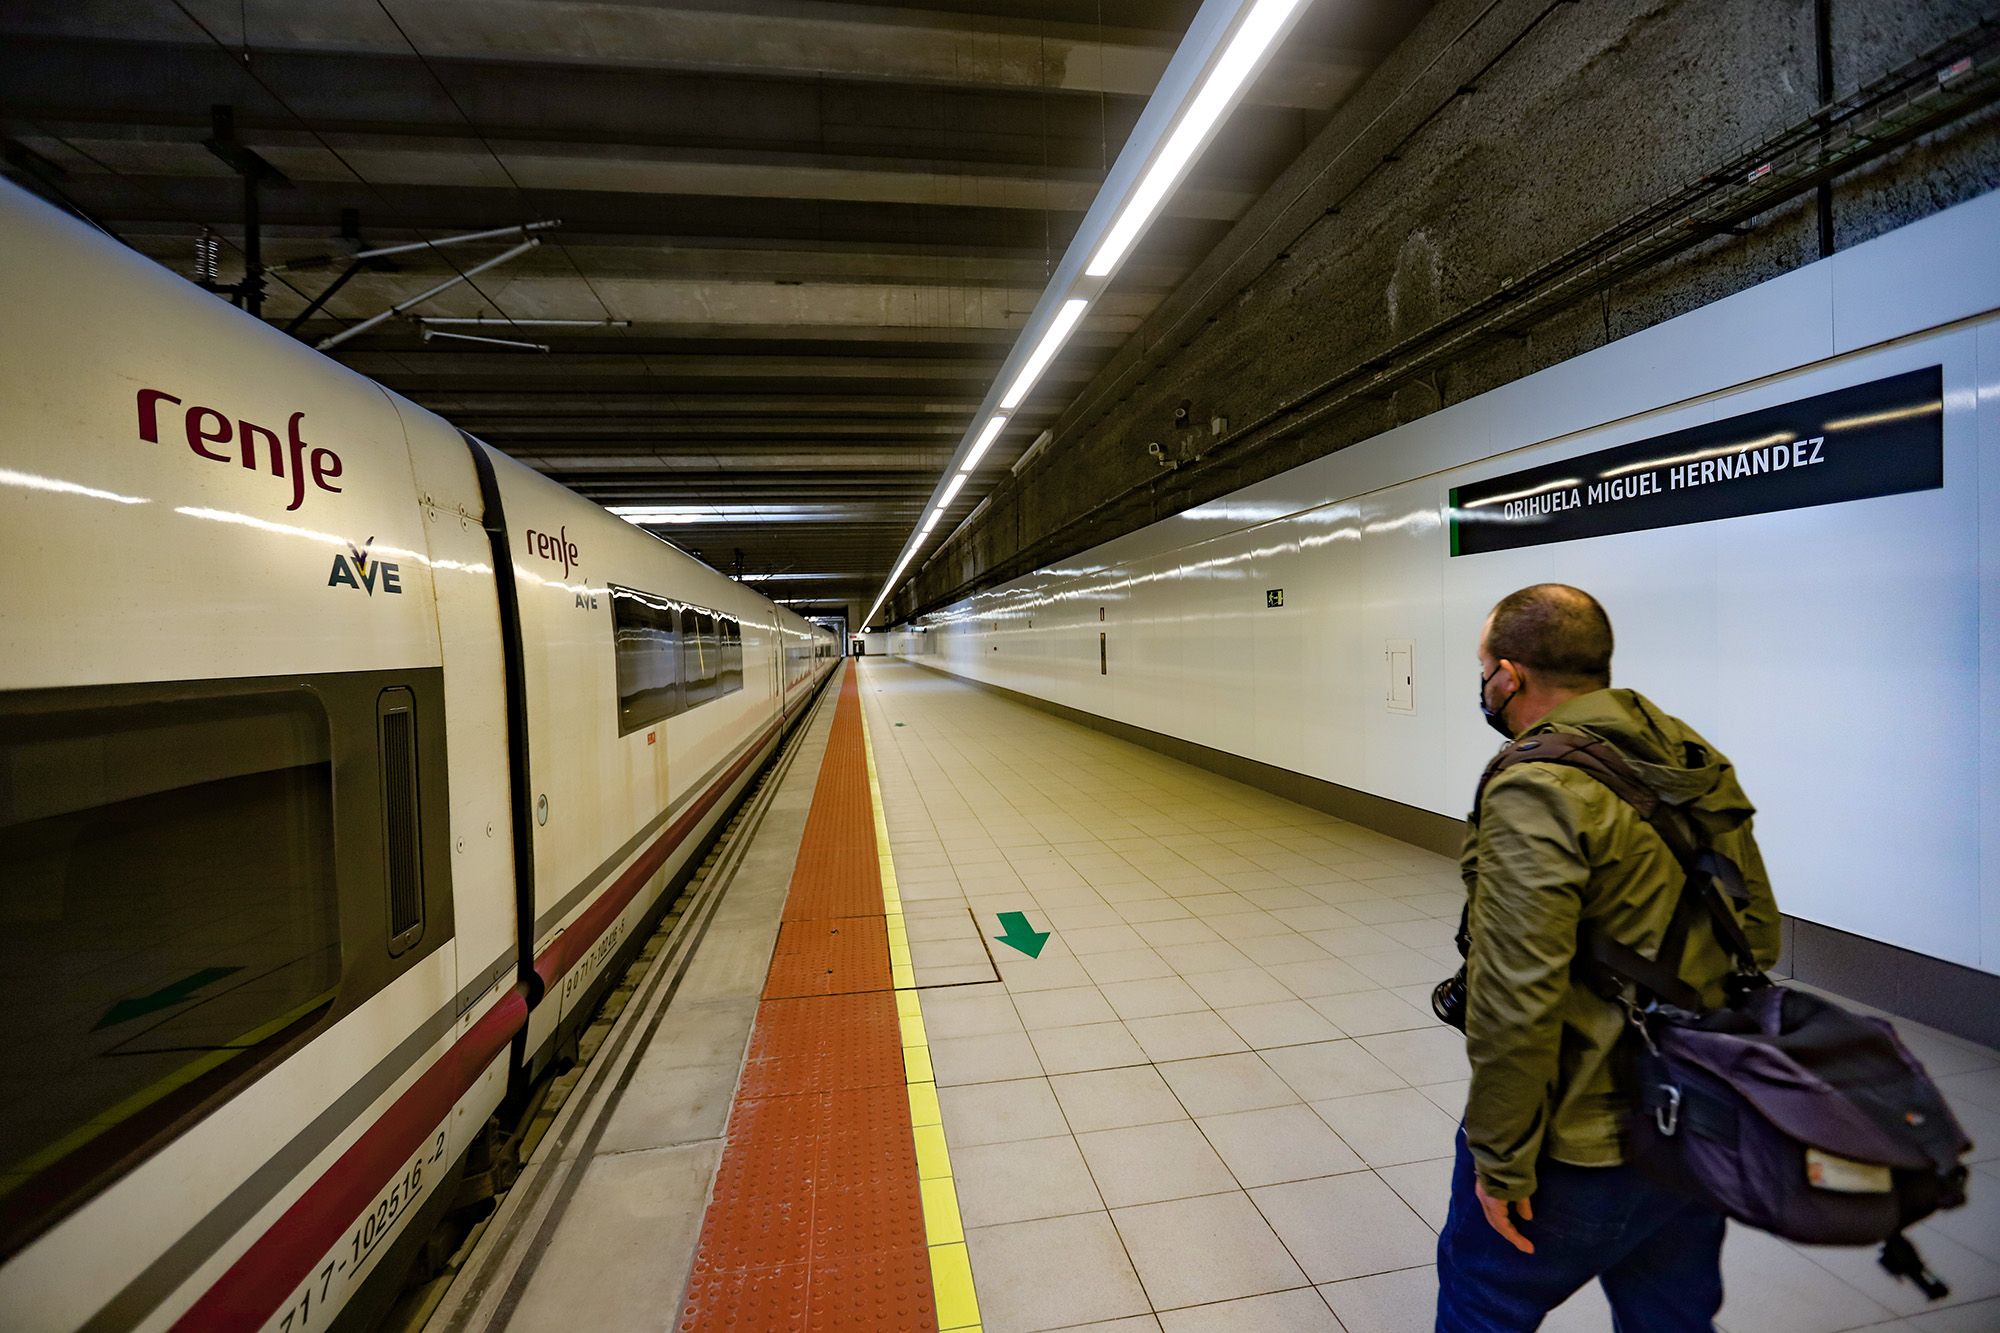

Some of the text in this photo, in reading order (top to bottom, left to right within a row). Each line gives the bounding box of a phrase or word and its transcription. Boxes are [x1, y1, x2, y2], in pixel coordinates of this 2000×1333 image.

[136, 388, 343, 512] renfe
[1504, 436, 1826, 522] ORIHUELA MIGUEL HERNÁNDEZ
[327, 536, 403, 598] AVE
[526, 525, 579, 580] renfe
[575, 592, 598, 612] AVE
